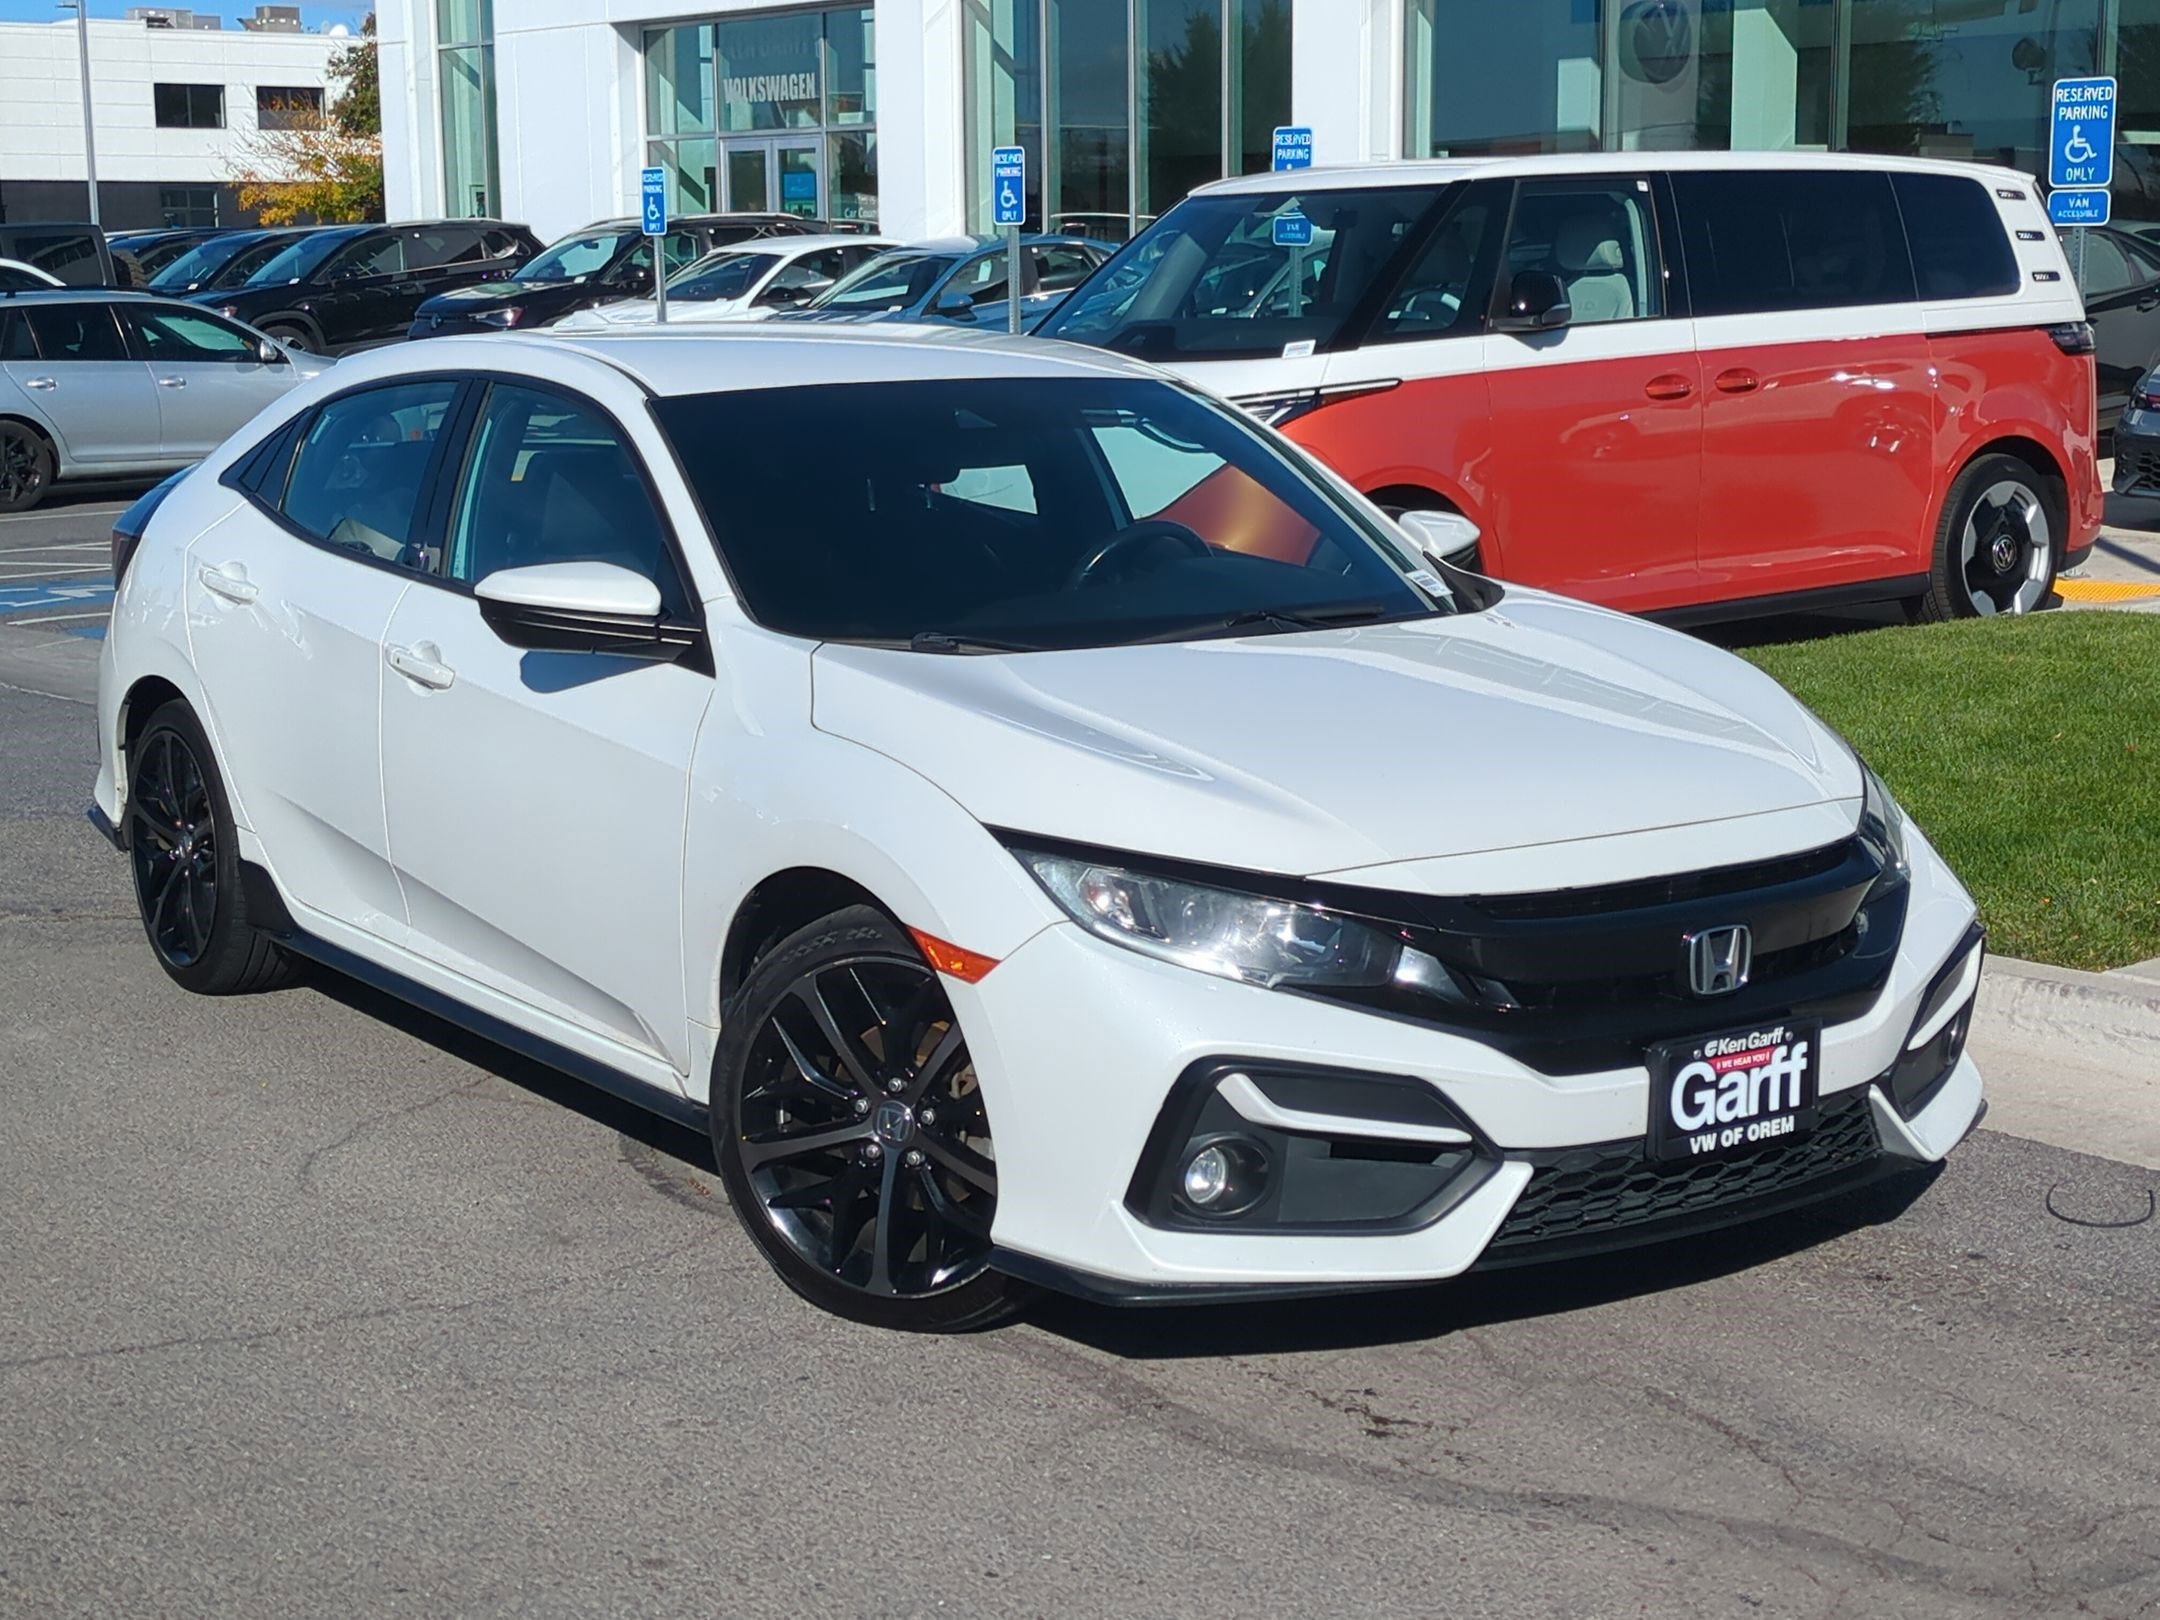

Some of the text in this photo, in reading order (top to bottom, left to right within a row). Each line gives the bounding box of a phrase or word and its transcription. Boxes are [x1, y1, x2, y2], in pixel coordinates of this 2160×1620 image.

[723, 72, 815, 104] VOLKSWAGEN
[2056, 86, 2113, 103] RESERVED
[2058, 105, 2108, 121] PARKING
[1275, 134, 1311, 145] RESERVED
[1277, 148, 1309, 160] PARKING
[2066, 167, 2095, 181] ONLY
[2068, 198, 2090, 209] VAN
[2057, 209, 2098, 218] ACCESSIBLE
[1717, 1026, 1784, 1056] Ken Garff
[1733, 1056, 1752, 1066] HEAR
[1753, 1054, 1765, 1063] YOU
[1670, 1041, 1808, 1131] Garff
[1690, 1115, 1795, 1154] VW OF OREM
